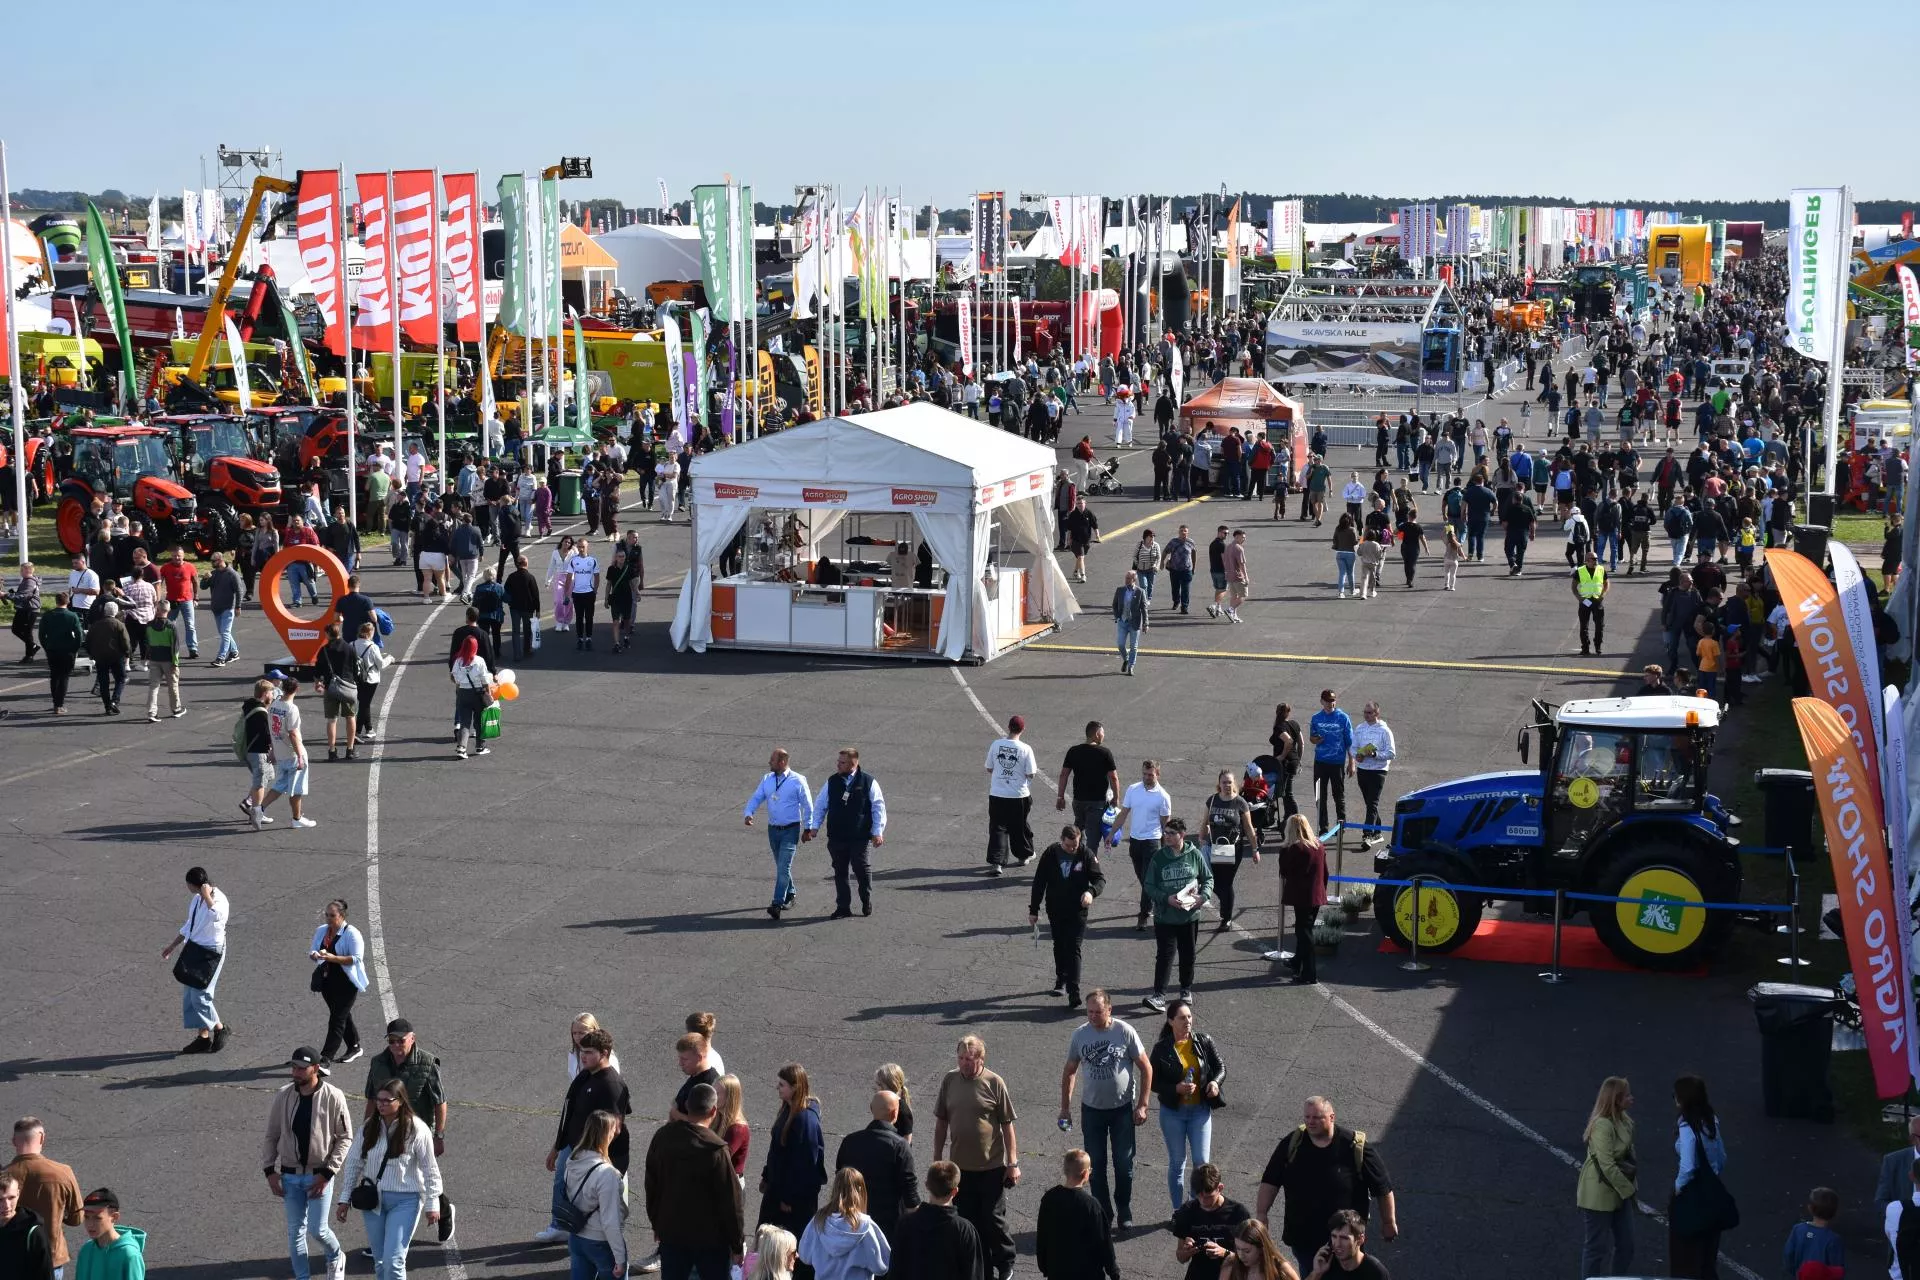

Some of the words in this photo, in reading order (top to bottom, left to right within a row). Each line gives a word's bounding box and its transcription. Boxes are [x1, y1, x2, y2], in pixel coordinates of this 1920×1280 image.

[1302, 328, 1343, 337] SKAVSKA
[1344, 328, 1368, 337] HALE
[1422, 378, 1450, 387] Tractor
[894, 493, 914, 501] AGRO
[914, 494, 936, 502] SHOW
[1448, 790, 1520, 803] FARMTRAC
